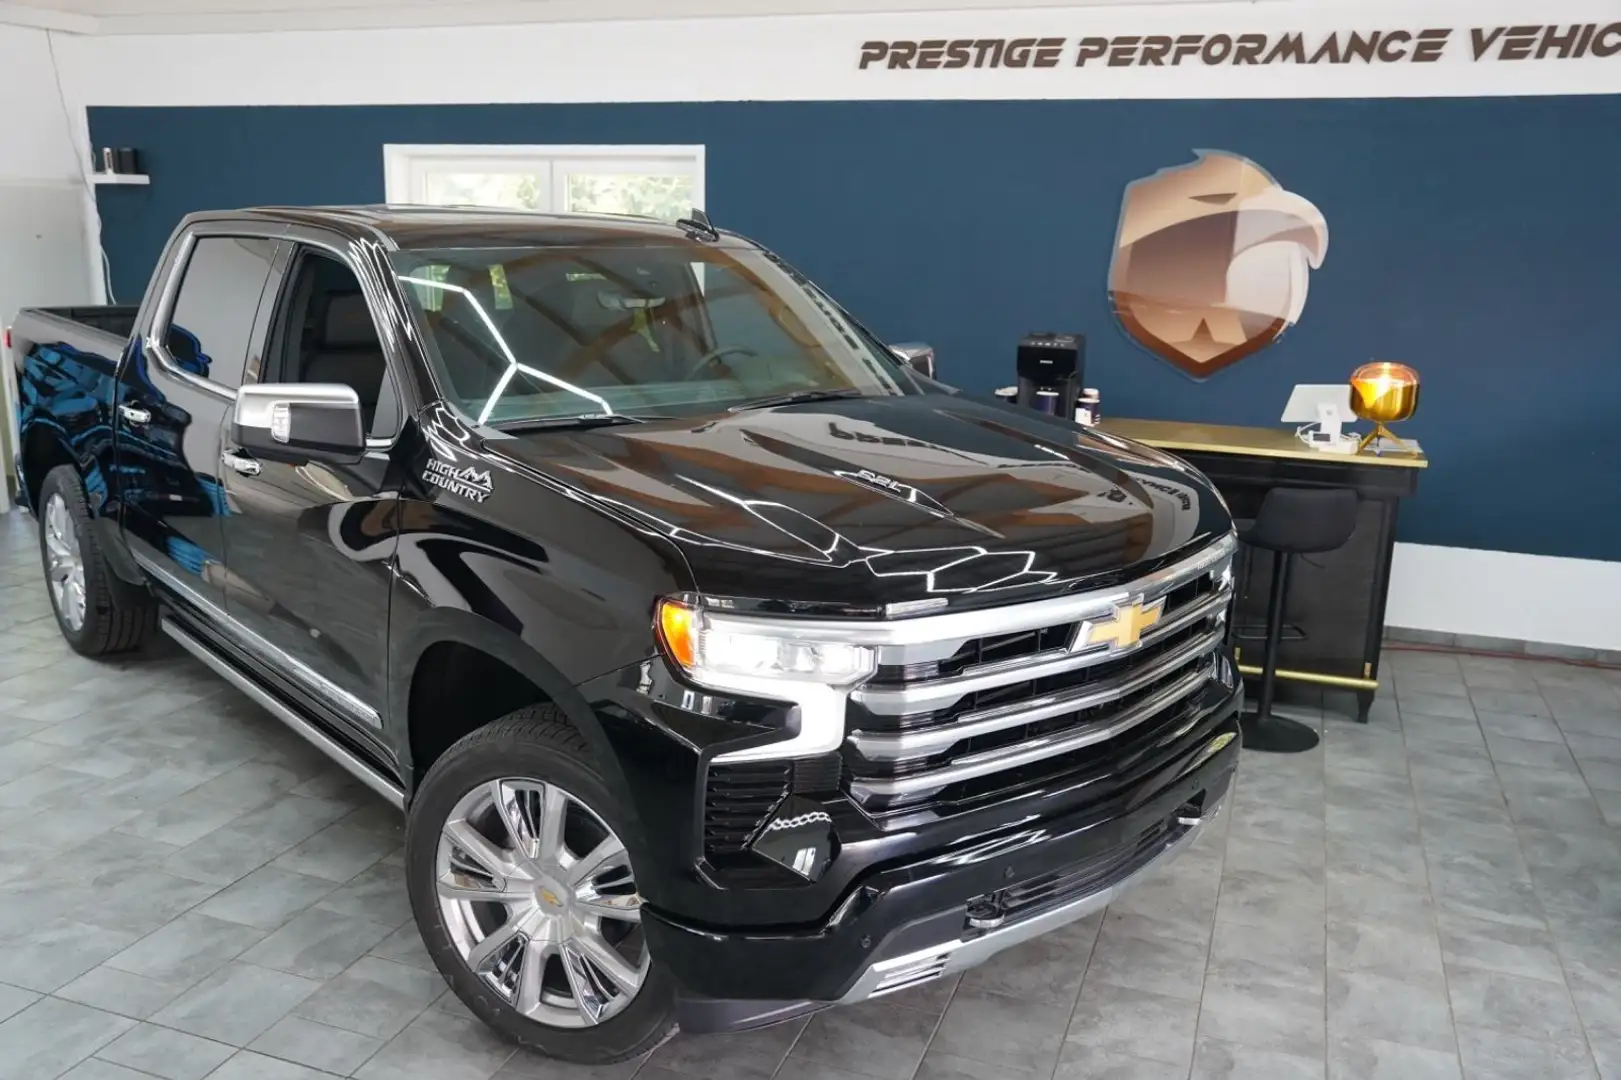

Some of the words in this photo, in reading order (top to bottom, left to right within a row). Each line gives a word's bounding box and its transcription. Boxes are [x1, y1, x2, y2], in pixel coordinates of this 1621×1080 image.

[859, 37, 1066, 70] PRESTIGE
[1075, 28, 1453, 68] PERFORMANCE
[1470, 21, 1621, 62] VEHIC
[426, 458, 462, 480] HIGH
[422, 470, 490, 503] COUNTRY
